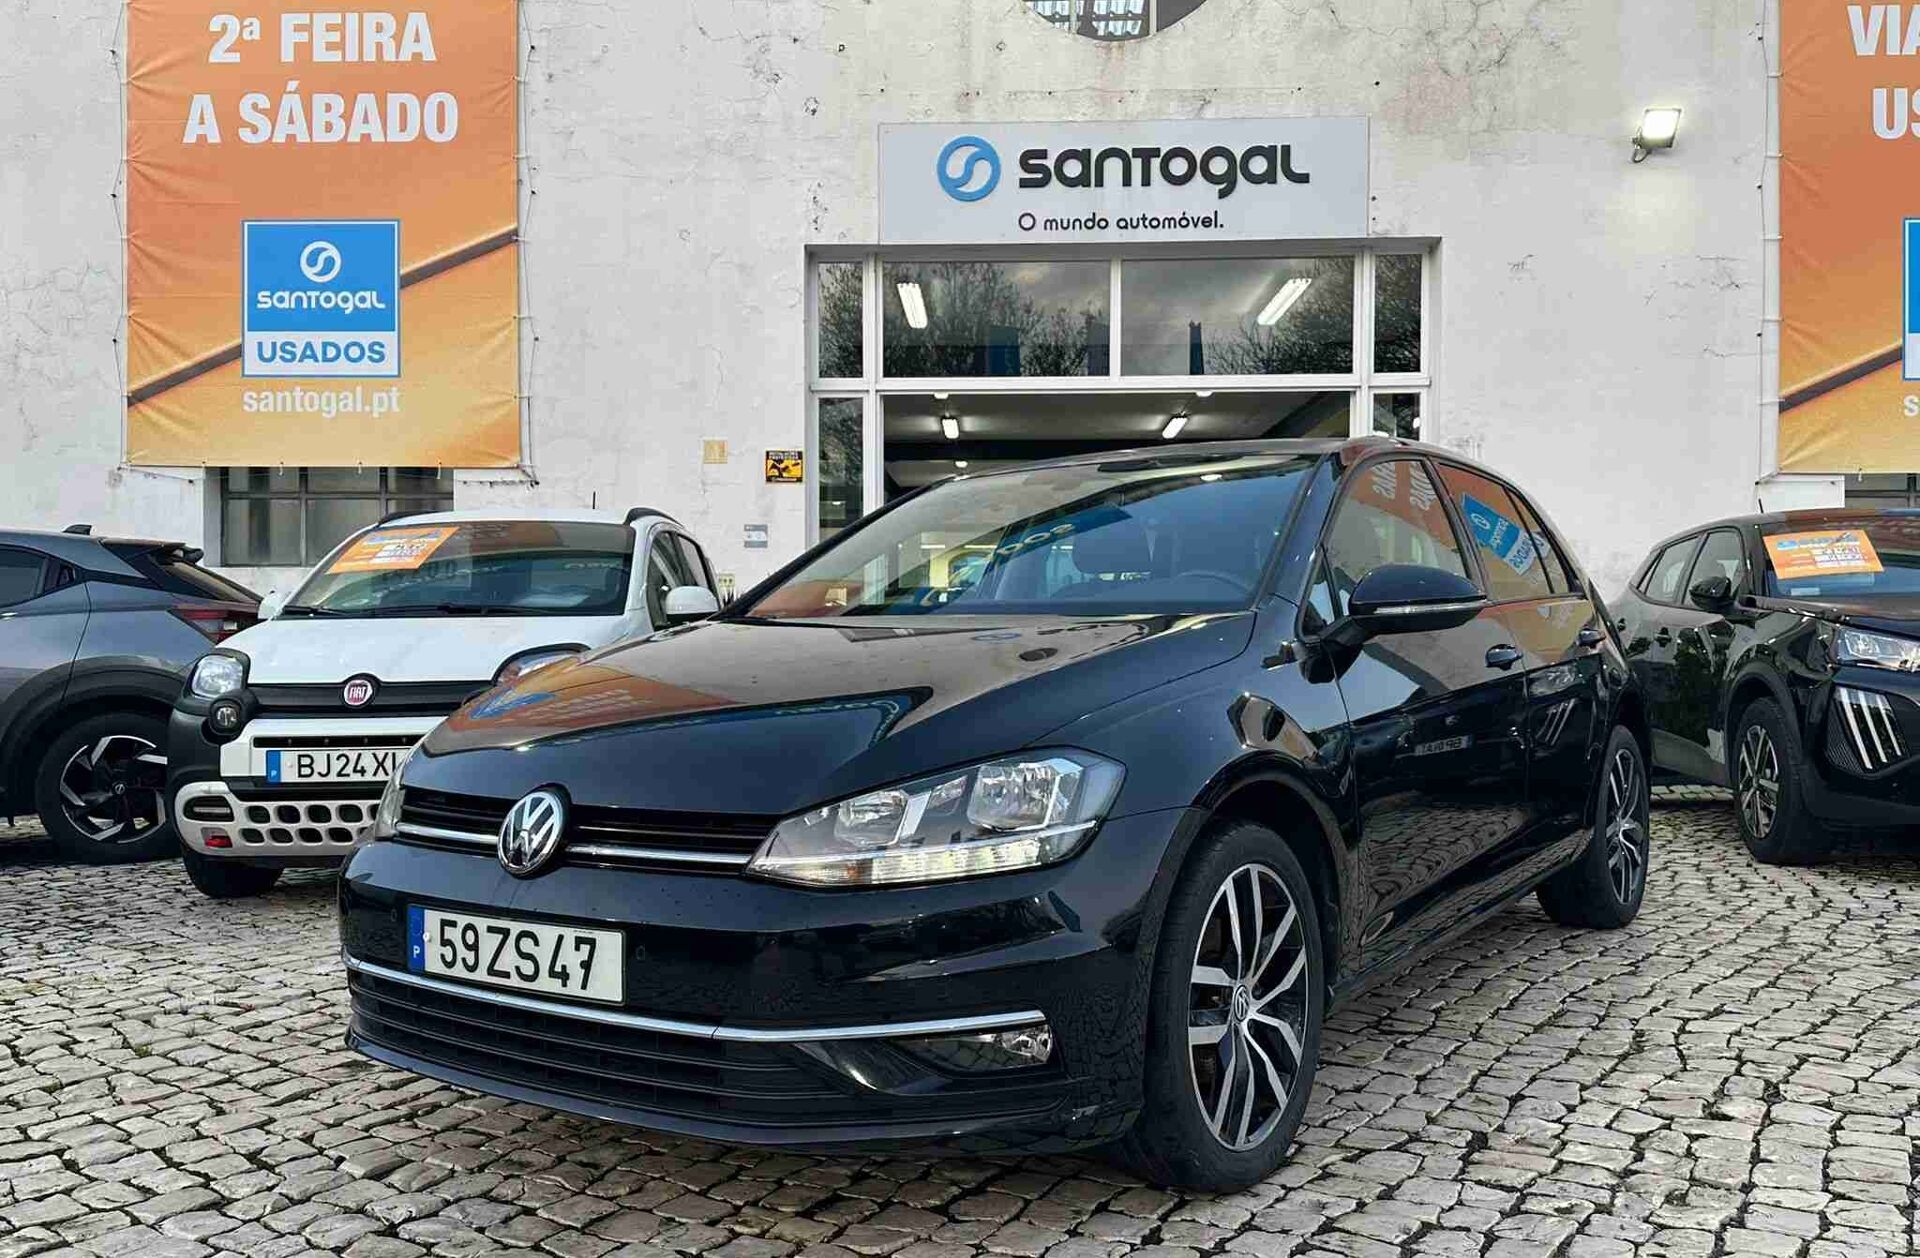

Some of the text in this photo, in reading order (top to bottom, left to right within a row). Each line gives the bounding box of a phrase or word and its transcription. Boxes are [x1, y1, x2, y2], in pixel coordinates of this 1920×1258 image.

[280, 11, 437, 63] FEIRA
[182, 81, 459, 145] A SÁBADO
[1018, 209, 1225, 232] O mundo automóvel.
[256, 340, 386, 364] USADOS
[242, 385, 399, 418] santogal.pt
[412, 945, 421, 959] P
